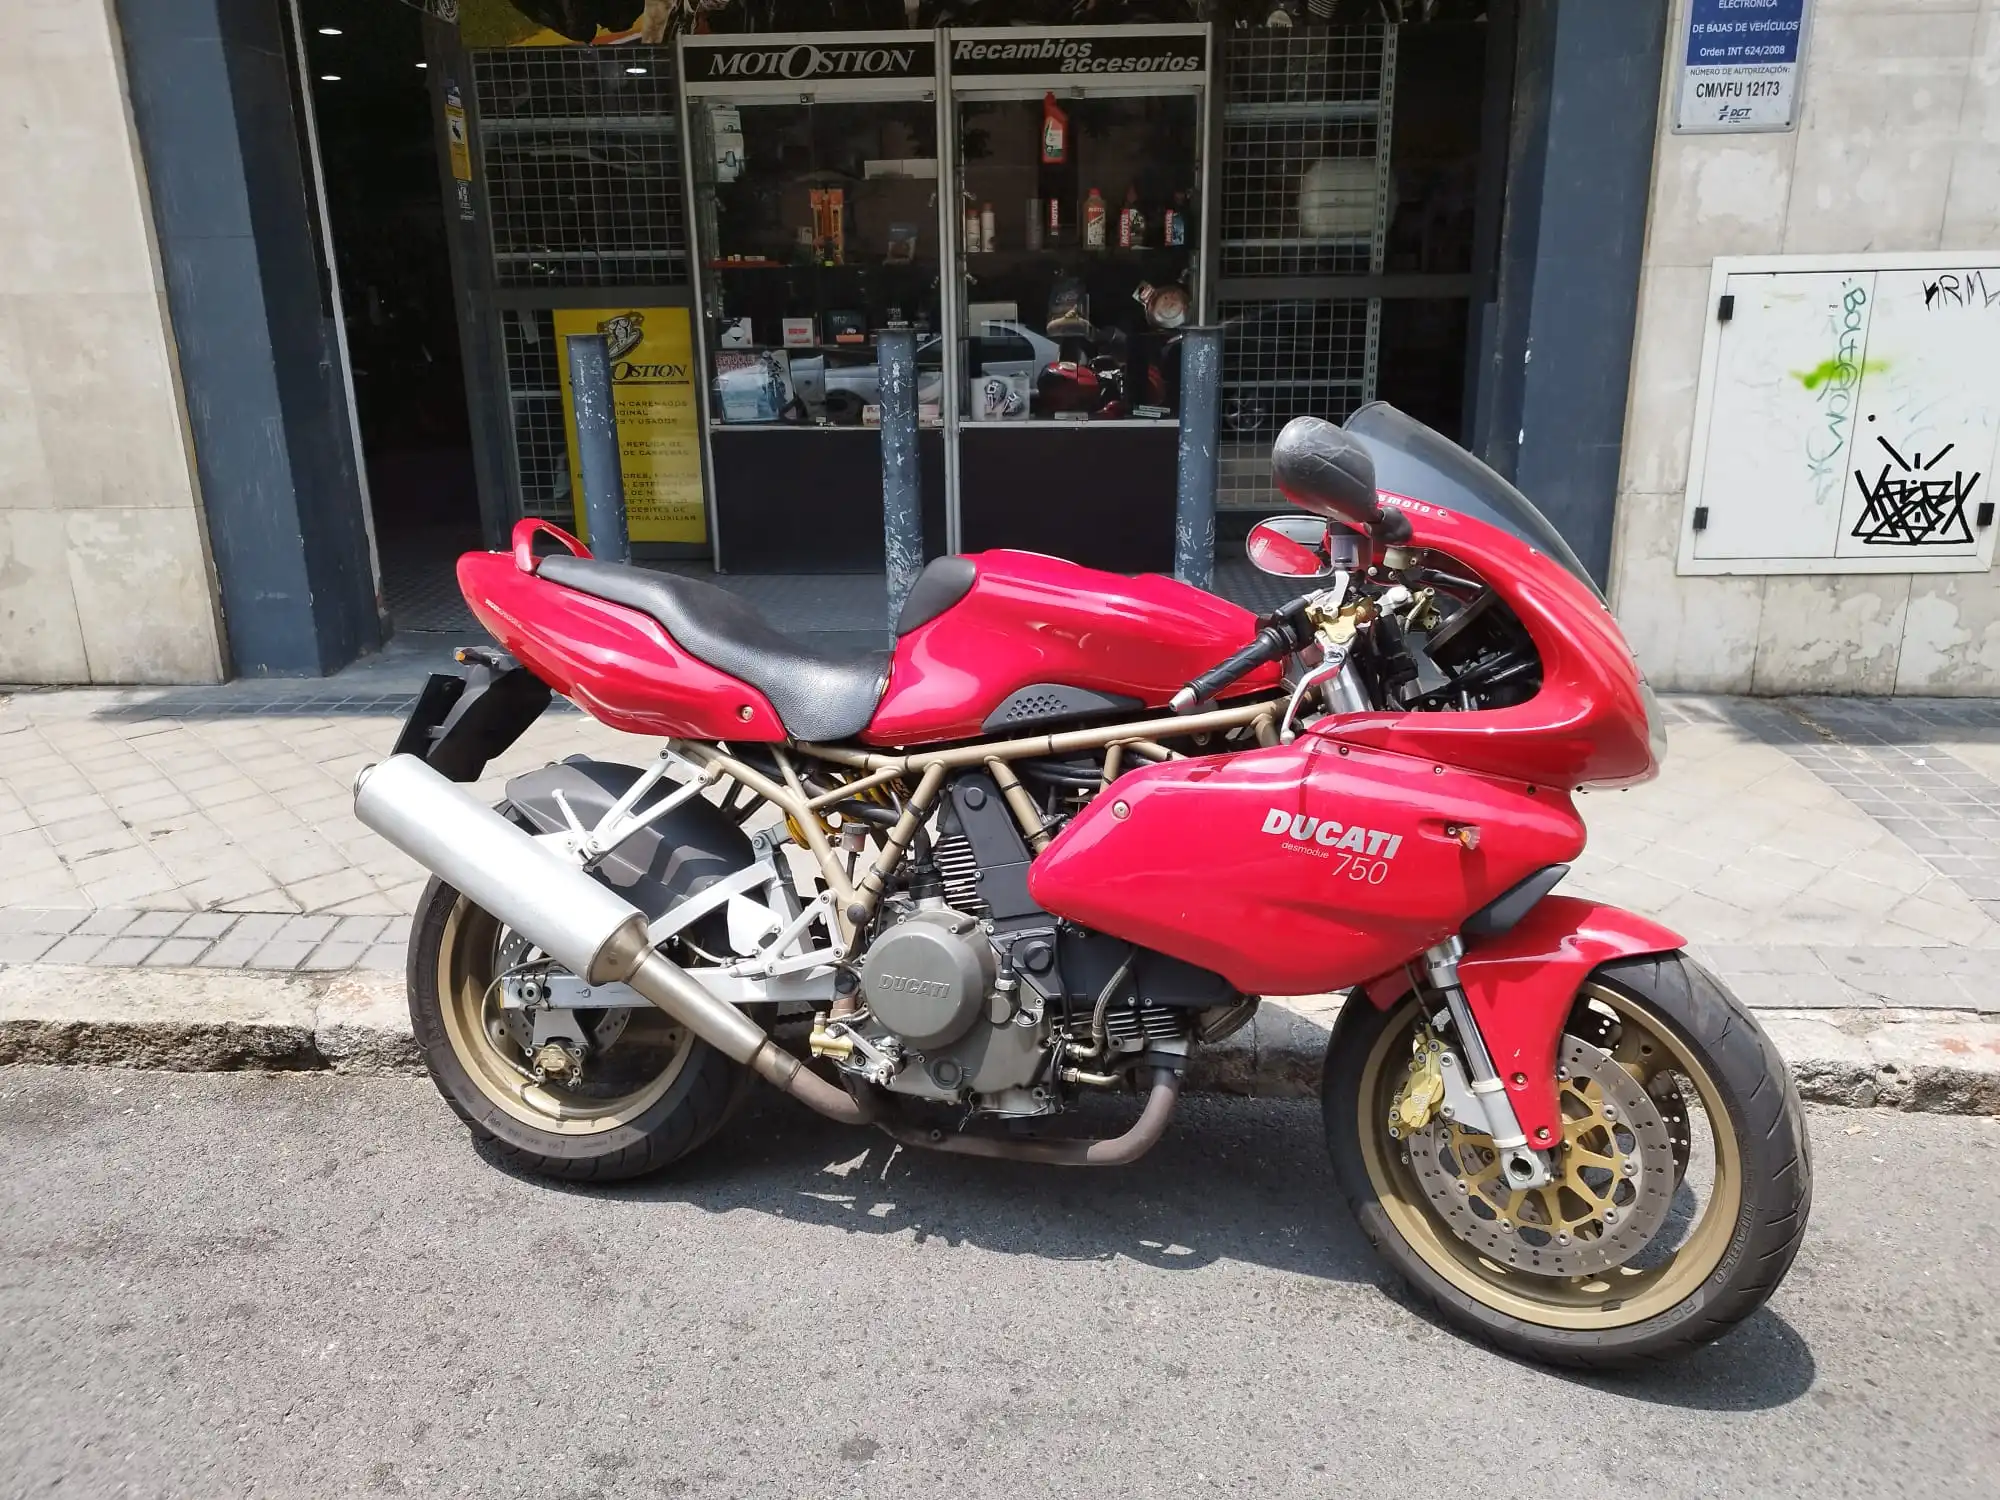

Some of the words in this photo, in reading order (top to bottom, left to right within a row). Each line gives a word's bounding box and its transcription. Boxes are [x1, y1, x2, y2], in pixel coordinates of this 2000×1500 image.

[1693, 24, 1704, 33] DE
[1706, 23, 1733, 33] BAJAS
[1735, 23, 1748, 32] DE
[1750, 19, 1799, 32] VEHÍCULOS
[954, 39, 1093, 60] Recambios
[1700, 47, 1725, 57] Orden
[1727, 47, 1743, 56] INT
[1744, 45, 1786, 56] 624/2008
[1060, 52, 1200, 73] accesorios
[1722, 67, 1732, 75] DE
[1696, 82, 1743, 98] CM/VFU
[1746, 81, 1780, 97] 12173
[613, 361, 688, 381] OSTION
[1261, 807, 1403, 860] DUCATI
[1281, 840, 1330, 859] desmodue
[1332, 852, 1388, 885] 750
[879, 973, 950, 999] DUCATI
